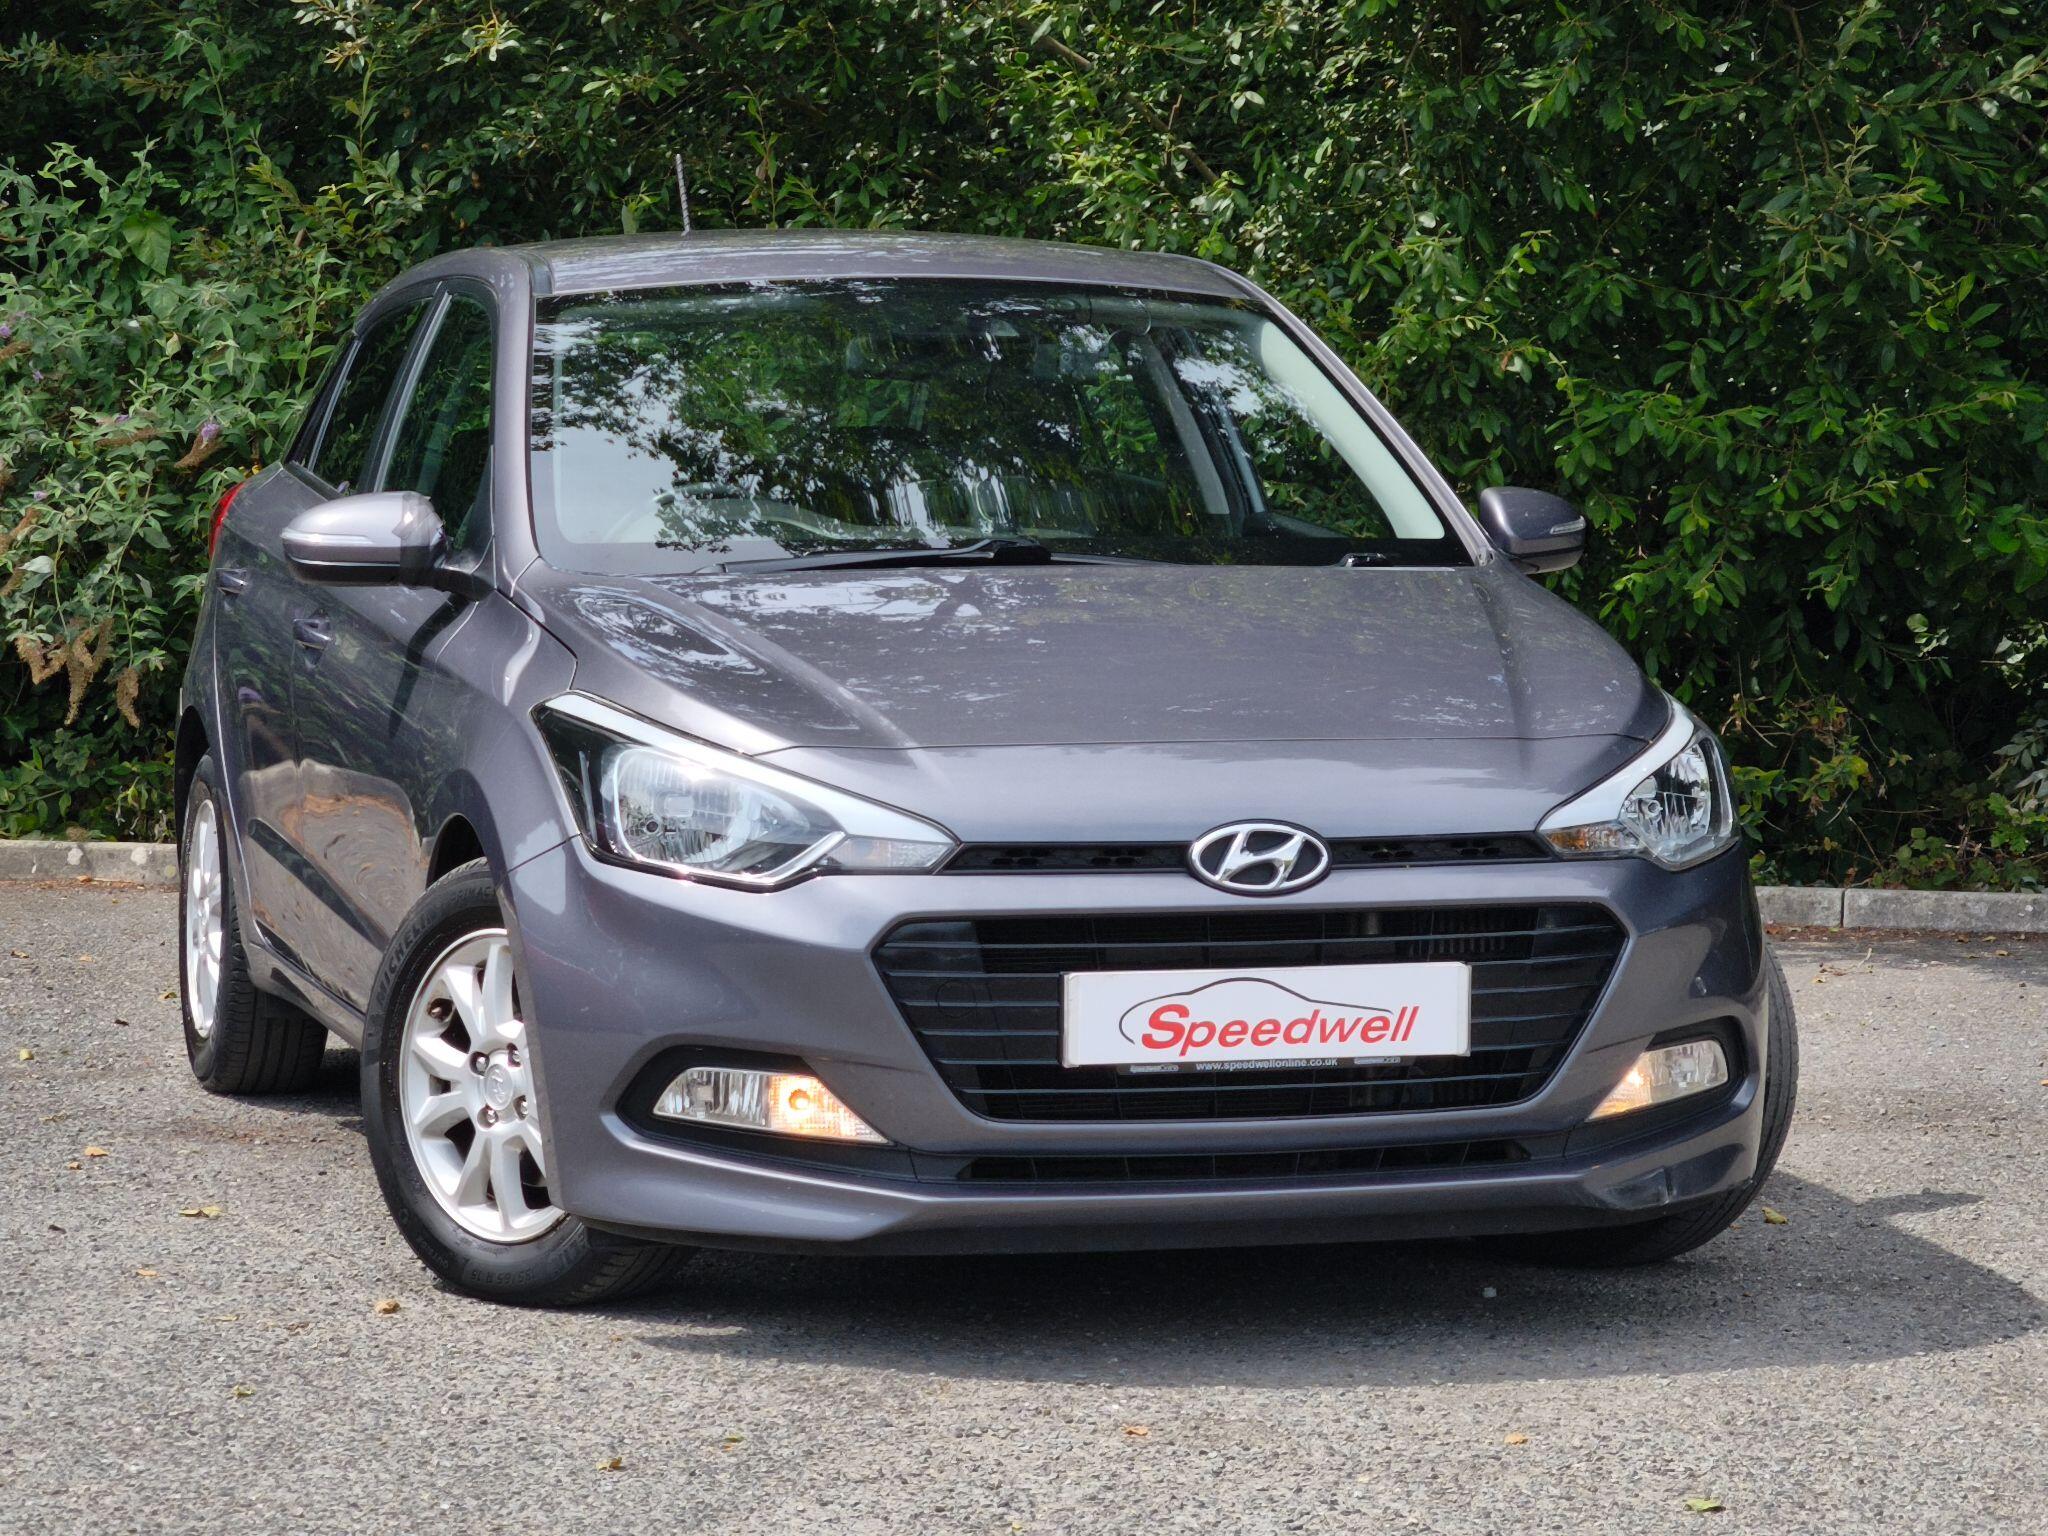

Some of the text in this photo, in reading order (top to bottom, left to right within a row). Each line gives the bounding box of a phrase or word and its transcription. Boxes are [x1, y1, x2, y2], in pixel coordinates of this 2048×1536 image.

[376, 909, 435, 1007] MICHELIN
[1141, 1004, 1420, 1057] Speedwell
[1195, 1057, 1338, 1071] www.speedwellonline.co.uk
